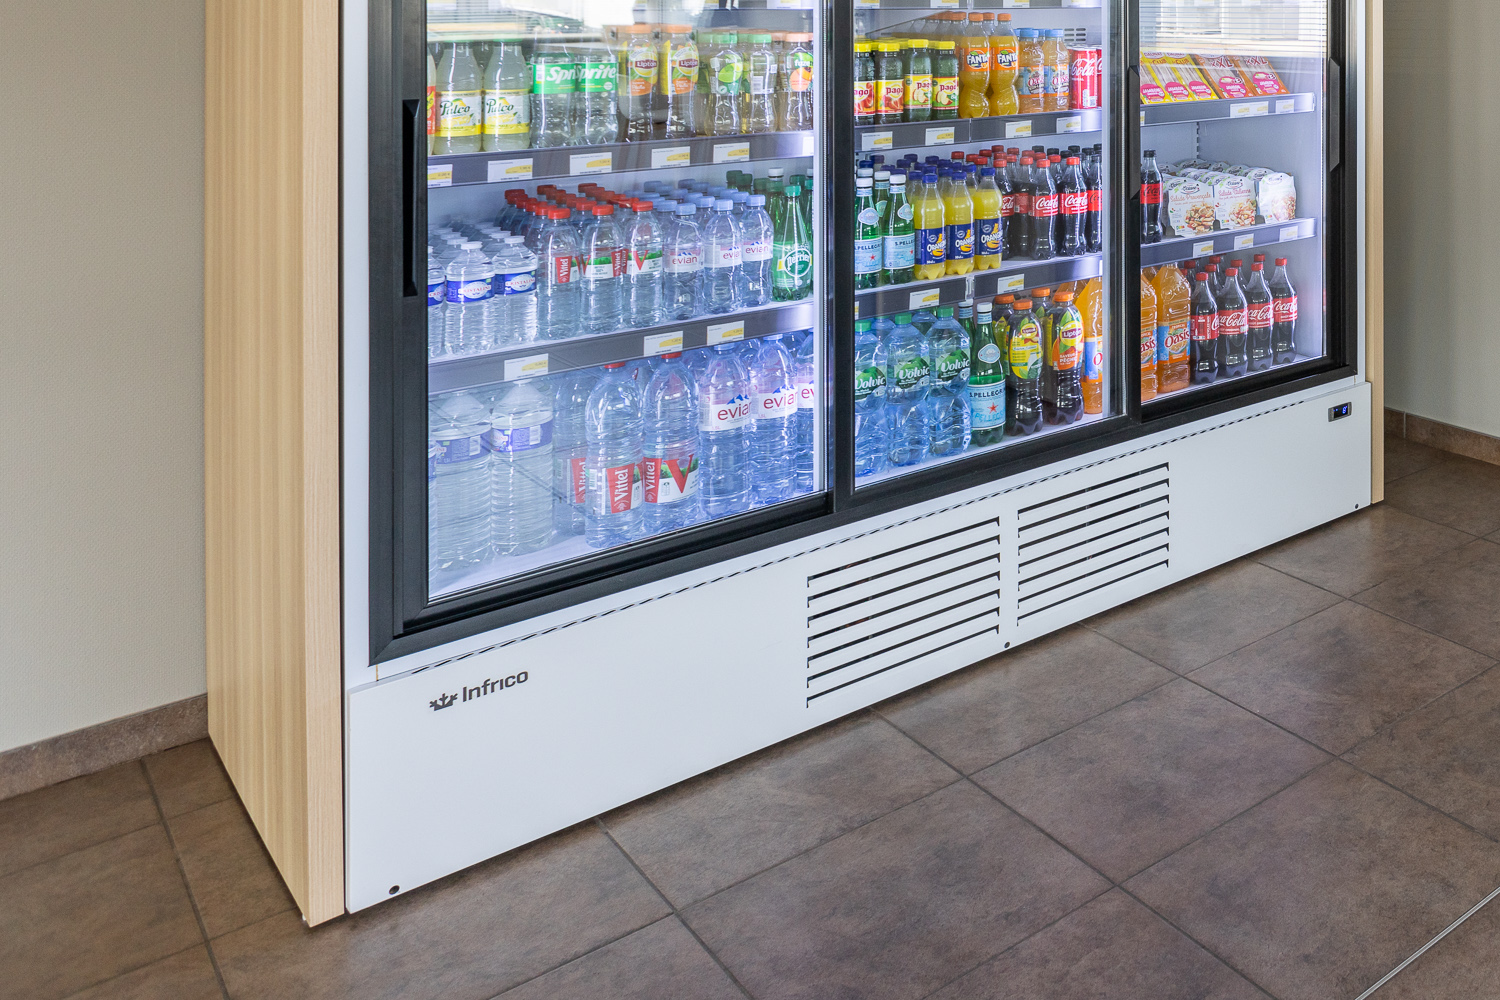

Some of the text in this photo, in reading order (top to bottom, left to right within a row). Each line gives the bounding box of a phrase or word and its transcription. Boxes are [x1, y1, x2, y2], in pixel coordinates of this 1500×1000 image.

[637, 60, 657, 68] Lipton
[681, 60, 698, 68] Lipton
[967, 53, 988, 65] FANTA
[997, 52, 1018, 64] FANTA
[1244, 56, 1268, 67] XXL
[546, 66, 576, 83] Spri
[576, 64, 617, 81] Sprite
[1072, 58, 1095, 76] Cola
[854, 87, 869, 97] ago
[440, 100, 470, 117] Pulco
[486, 97, 515, 115] Pulco
[723, 251, 741, 260] evia
[745, 244, 768, 254] evian
[559, 257, 569, 278] Vittel
[672, 255, 698, 265] evian
[1063, 328, 1083, 338] Lipton
[1164, 330, 1189, 348] Oasis
[1141, 337, 1156, 353] asis
[899, 365, 930, 380] Volvic
[941, 358, 970, 373] Volvic
[855, 375, 886, 390] Volvic
[717, 401, 750, 421] evia
[645, 461, 655, 491] Vittel
[614, 467, 629, 502] Vittel
[462, 670, 529, 702] Infrico
